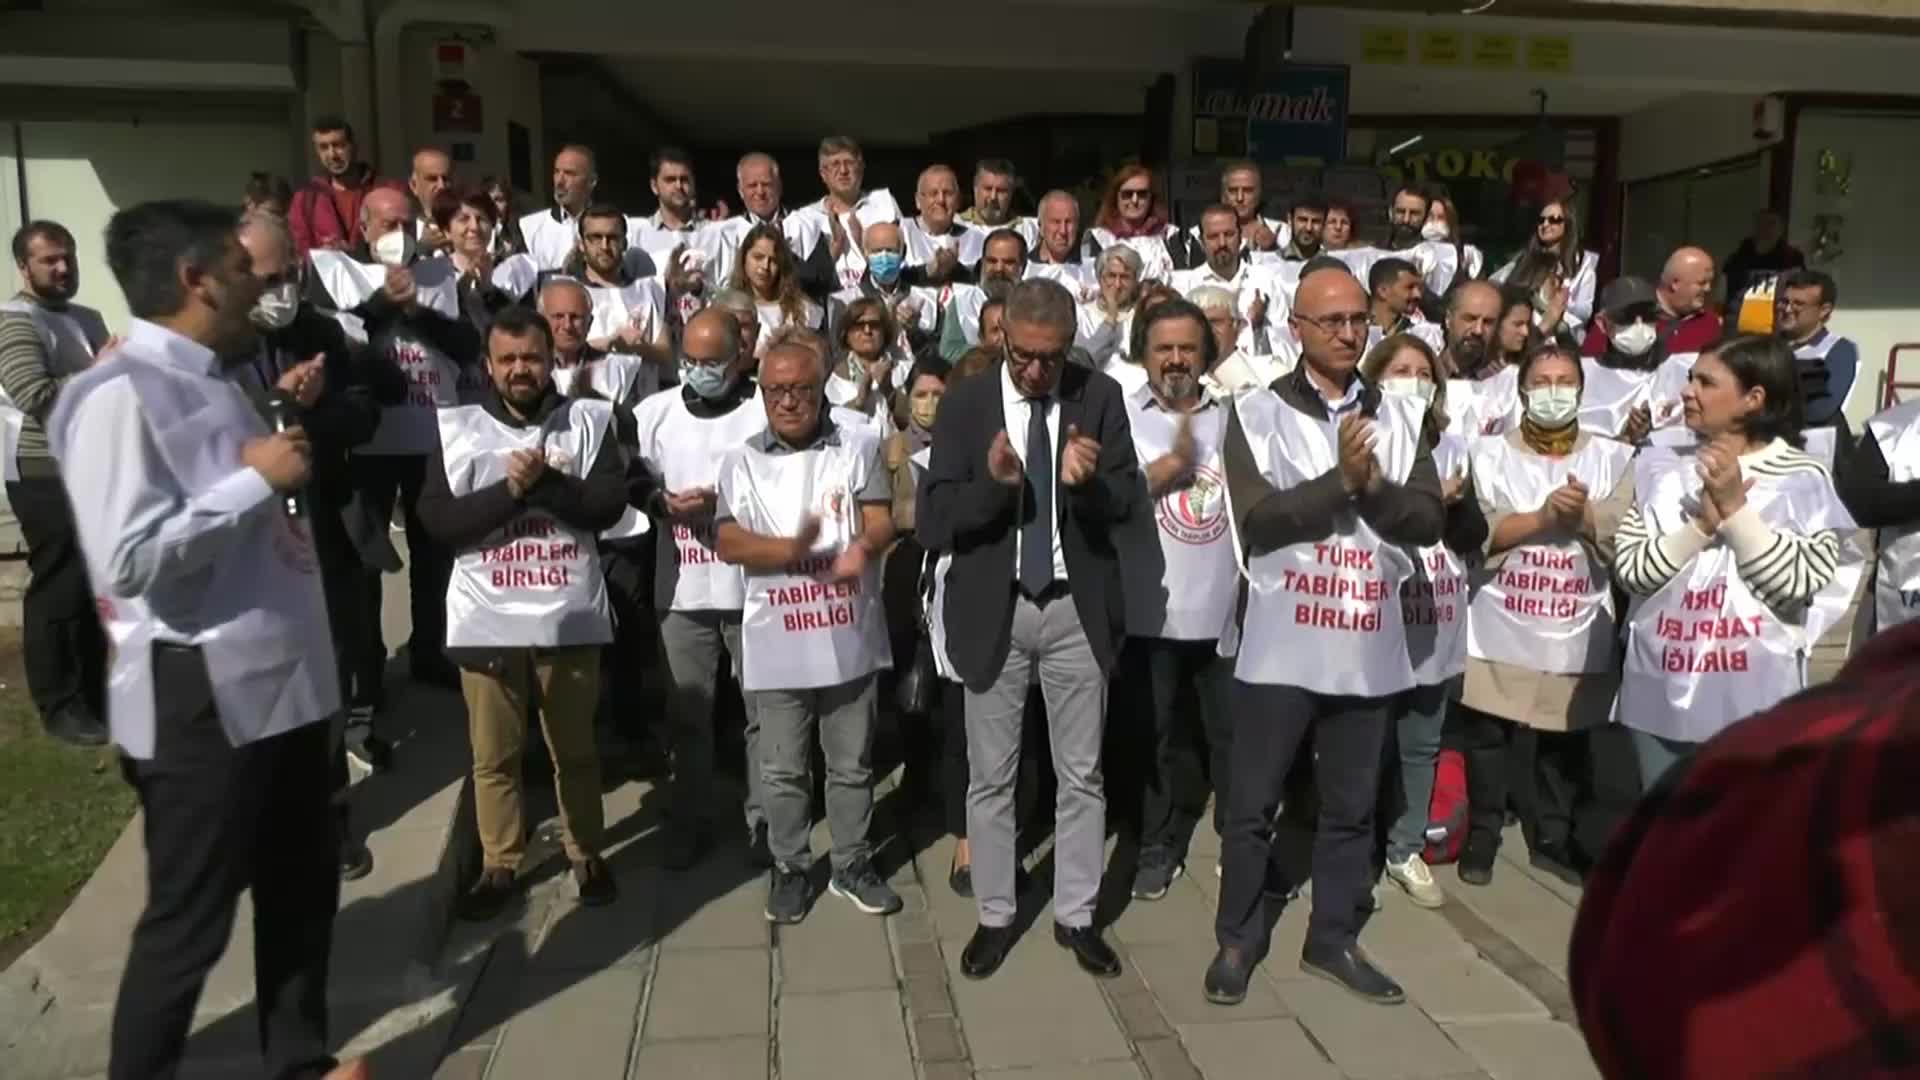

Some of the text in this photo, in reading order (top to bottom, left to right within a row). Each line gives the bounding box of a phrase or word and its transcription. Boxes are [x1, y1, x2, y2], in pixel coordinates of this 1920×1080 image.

[479, 543, 579, 563] TABİPLERİ
[1313, 540, 1374, 570] TÜRK
[1519, 548, 1575, 571] TÜRK
[491, 565, 569, 588] BİRLİĞİ
[1283, 571, 1390, 601] TABİPLER
[1496, 567, 1590, 595] TABİPLERİ
[783, 602, 855, 632] BİRLİĞİ
[1295, 602, 1381, 632] BİRLİĞİ
[1504, 593, 1577, 618] BİRLİĞİ
